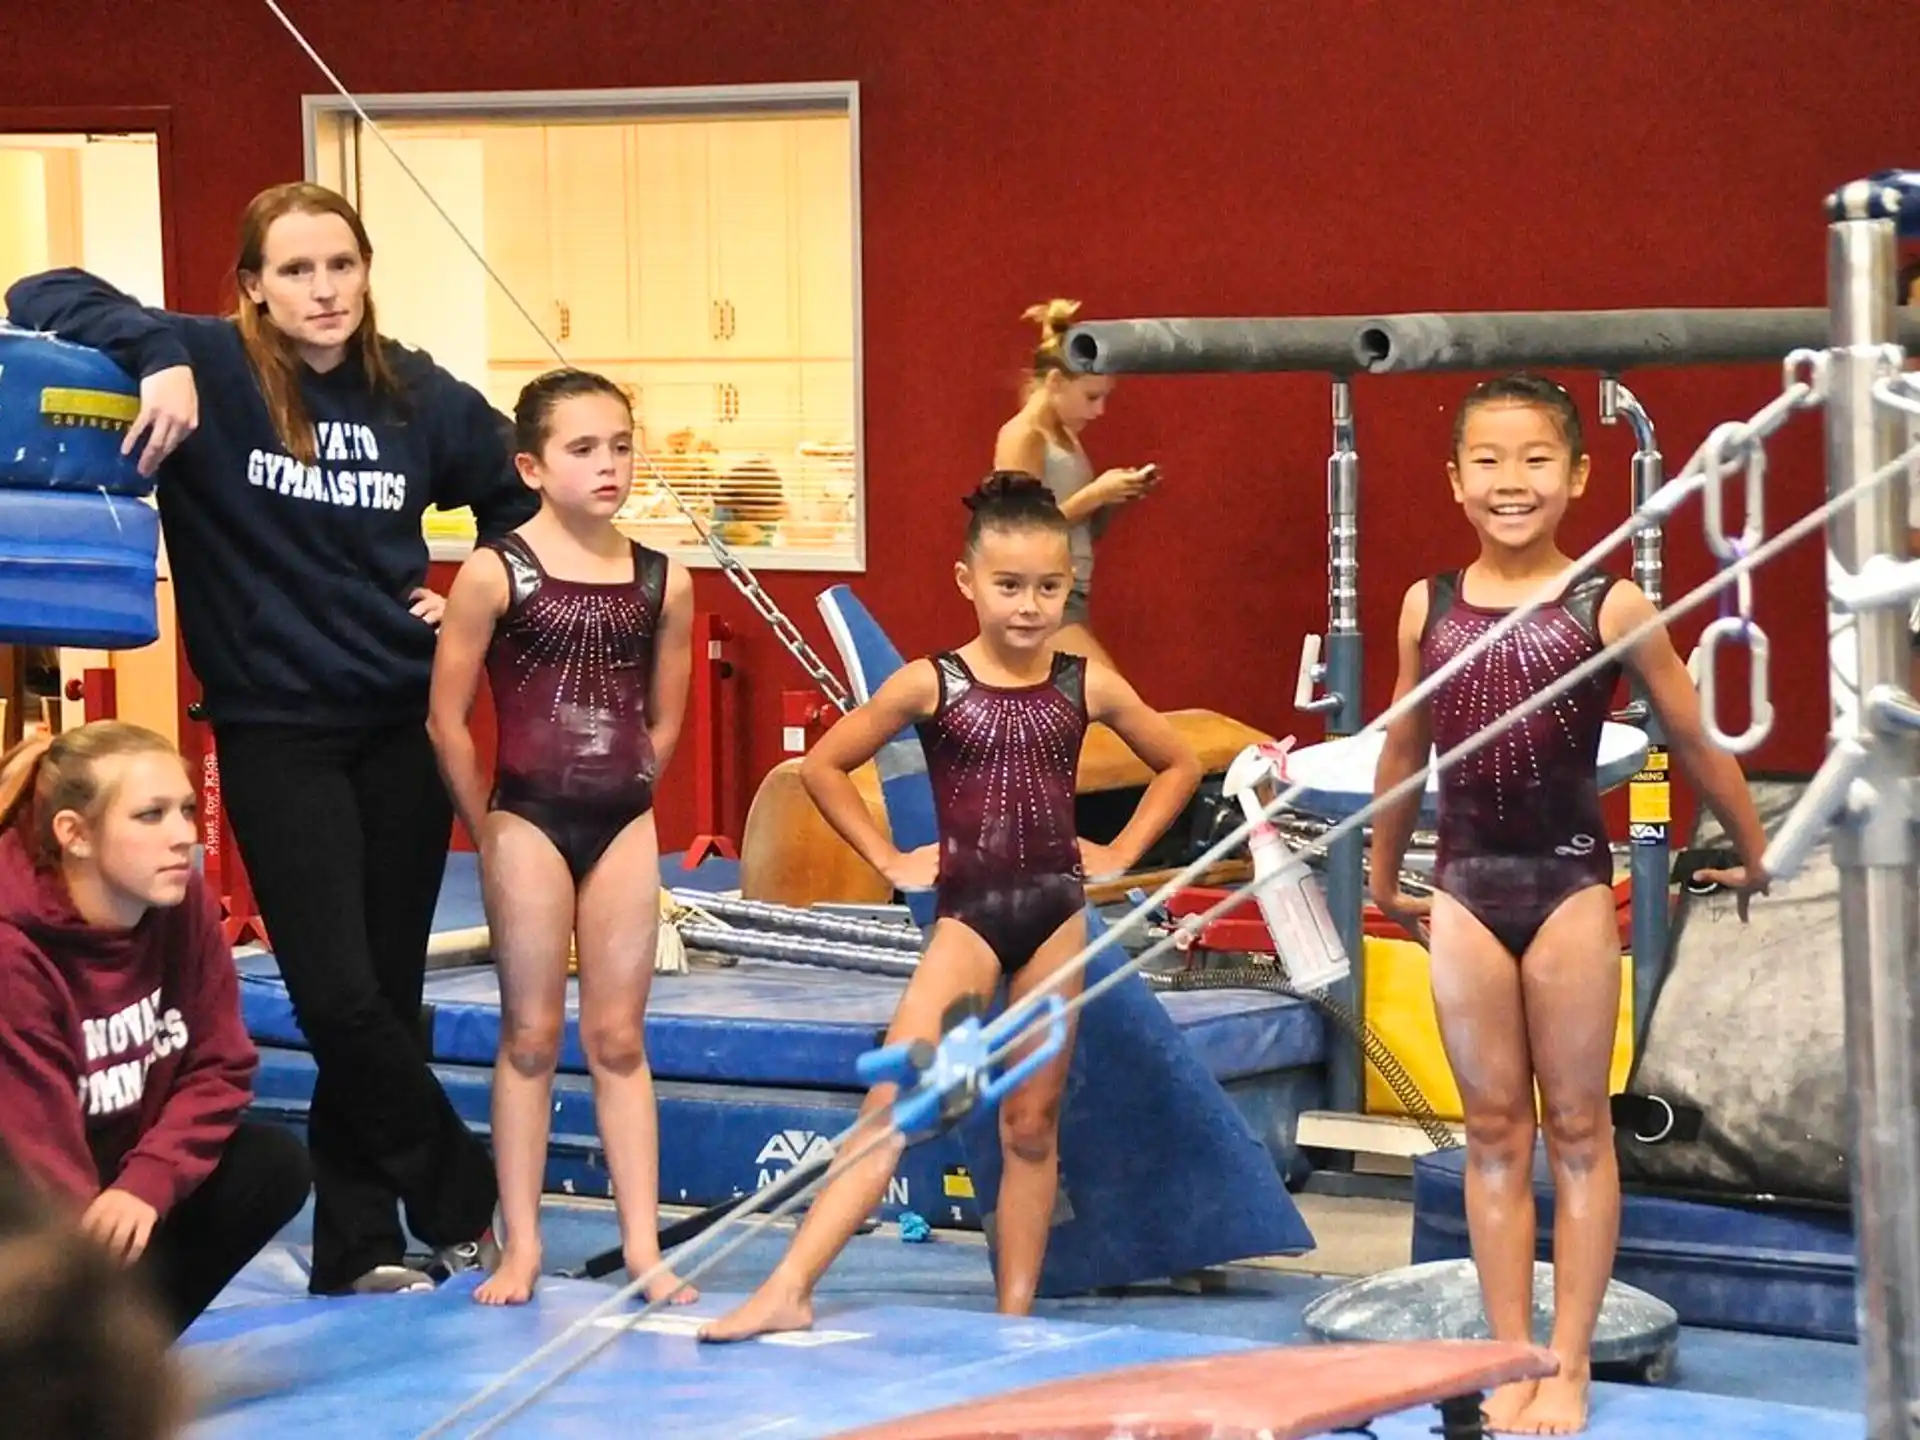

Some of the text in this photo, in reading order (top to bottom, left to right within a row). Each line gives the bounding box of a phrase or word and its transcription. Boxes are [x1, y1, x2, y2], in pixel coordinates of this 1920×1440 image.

[52, 414, 133, 432] ARNING
[247, 449, 406, 511] GYMNASTICS
[81, 986, 162, 1061] NOVA
